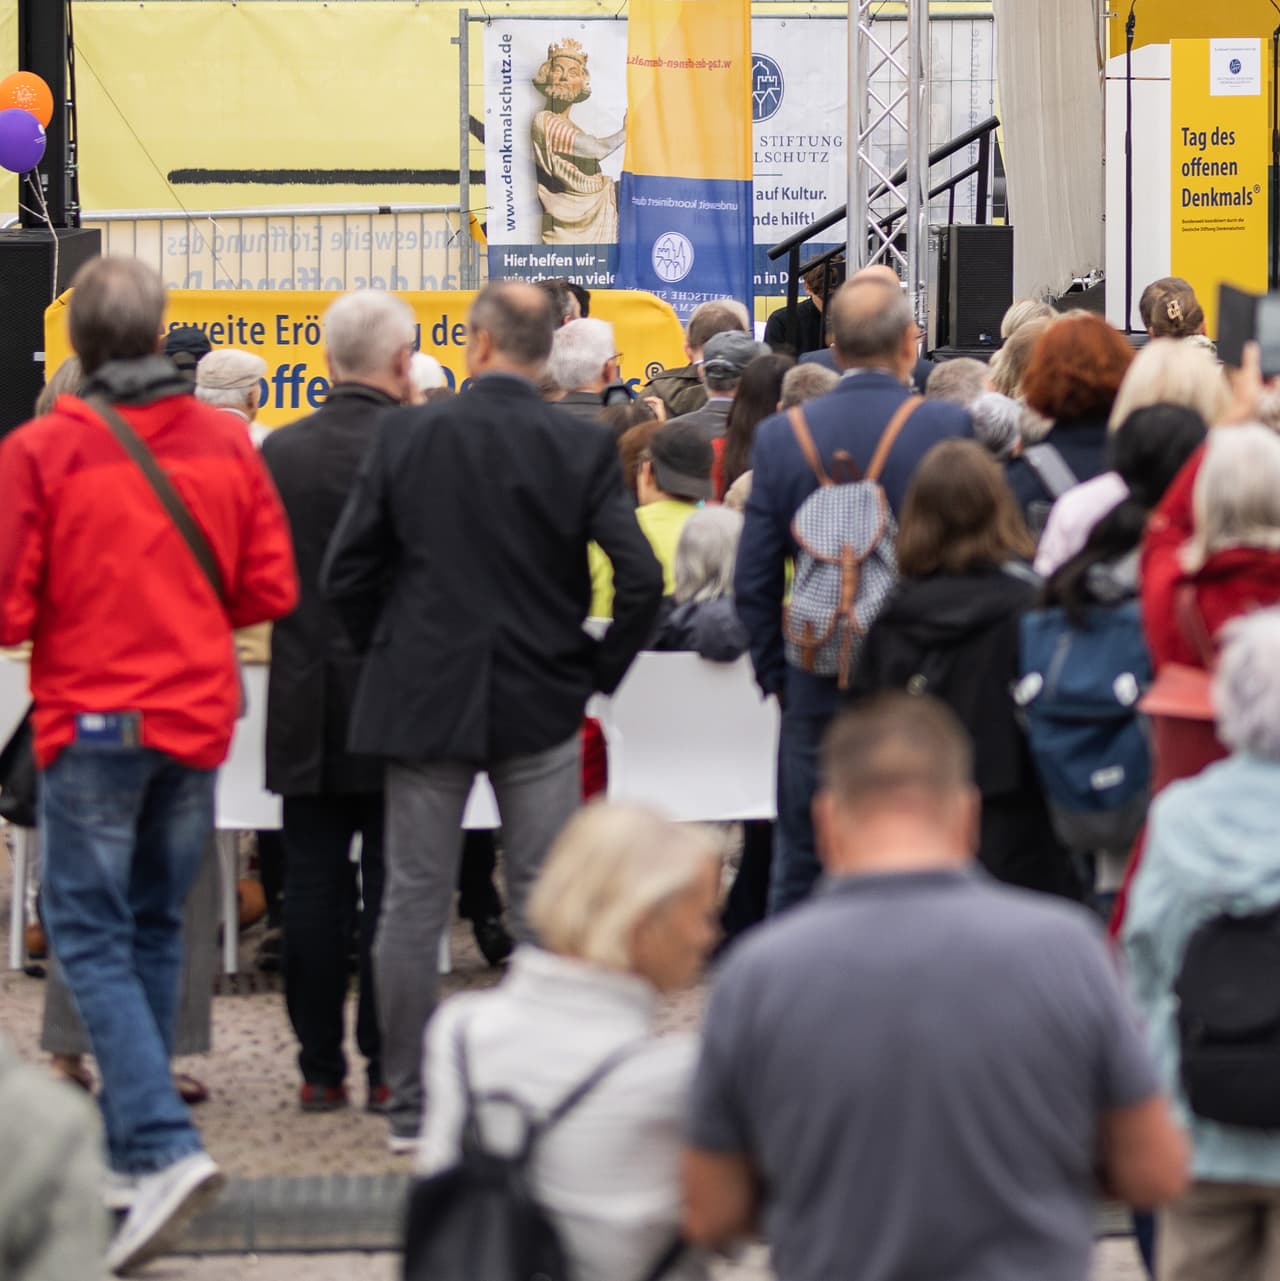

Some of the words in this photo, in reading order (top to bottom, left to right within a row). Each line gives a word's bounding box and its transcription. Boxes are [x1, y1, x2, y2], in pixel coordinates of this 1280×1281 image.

[498, 33, 516, 232] www.denkmalschutz.de
[1181, 127, 1207, 151] Tag
[1211, 126, 1236, 146] des
[759, 135, 843, 148] STIFTUNG
[754, 151, 829, 164] LSCHUTZ
[1181, 157, 1238, 176] offenen
[755, 186, 778, 201] auf
[781, 186, 827, 201] Kultur.
[503, 253, 528, 268] Hier
[529, 253, 573, 268] helfen
[575, 253, 596, 267] wir
[567, 274, 583, 285] an
[764, 272, 777, 285] in
